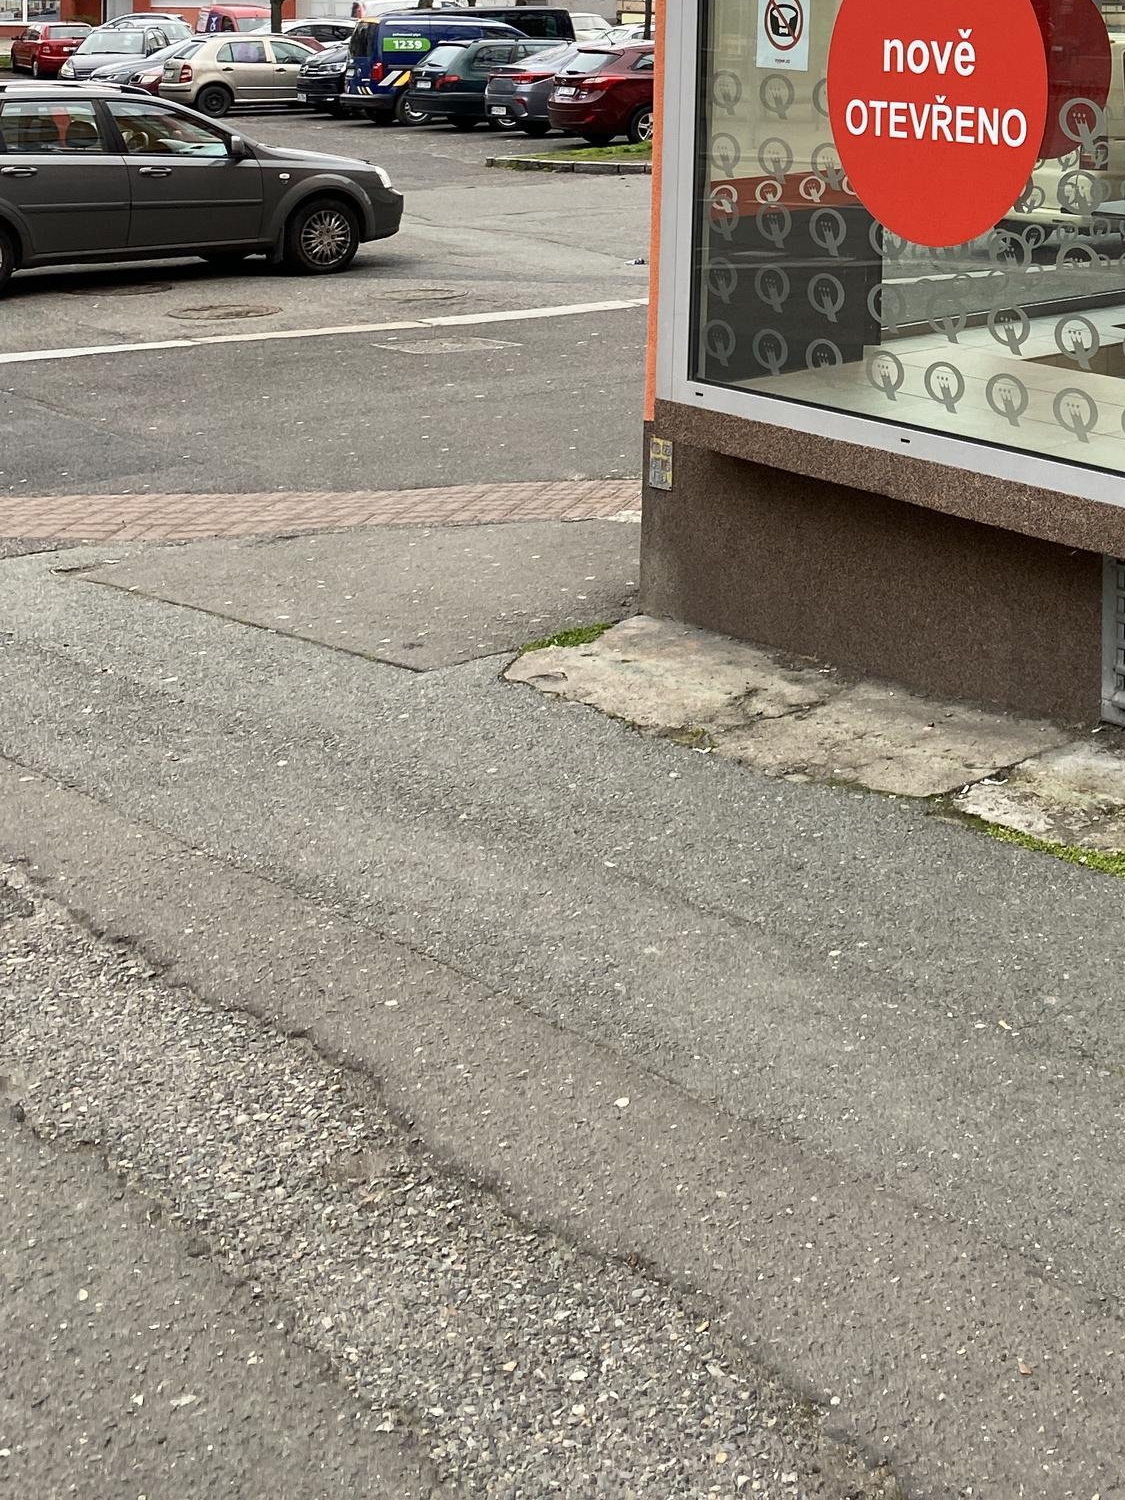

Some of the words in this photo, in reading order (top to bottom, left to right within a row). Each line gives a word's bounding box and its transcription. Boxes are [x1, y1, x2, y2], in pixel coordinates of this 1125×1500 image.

[393, 40, 422, 50] 1239
[883, 28, 976, 76] nově
[845, 94, 1027, 148] OTEVŘENO
